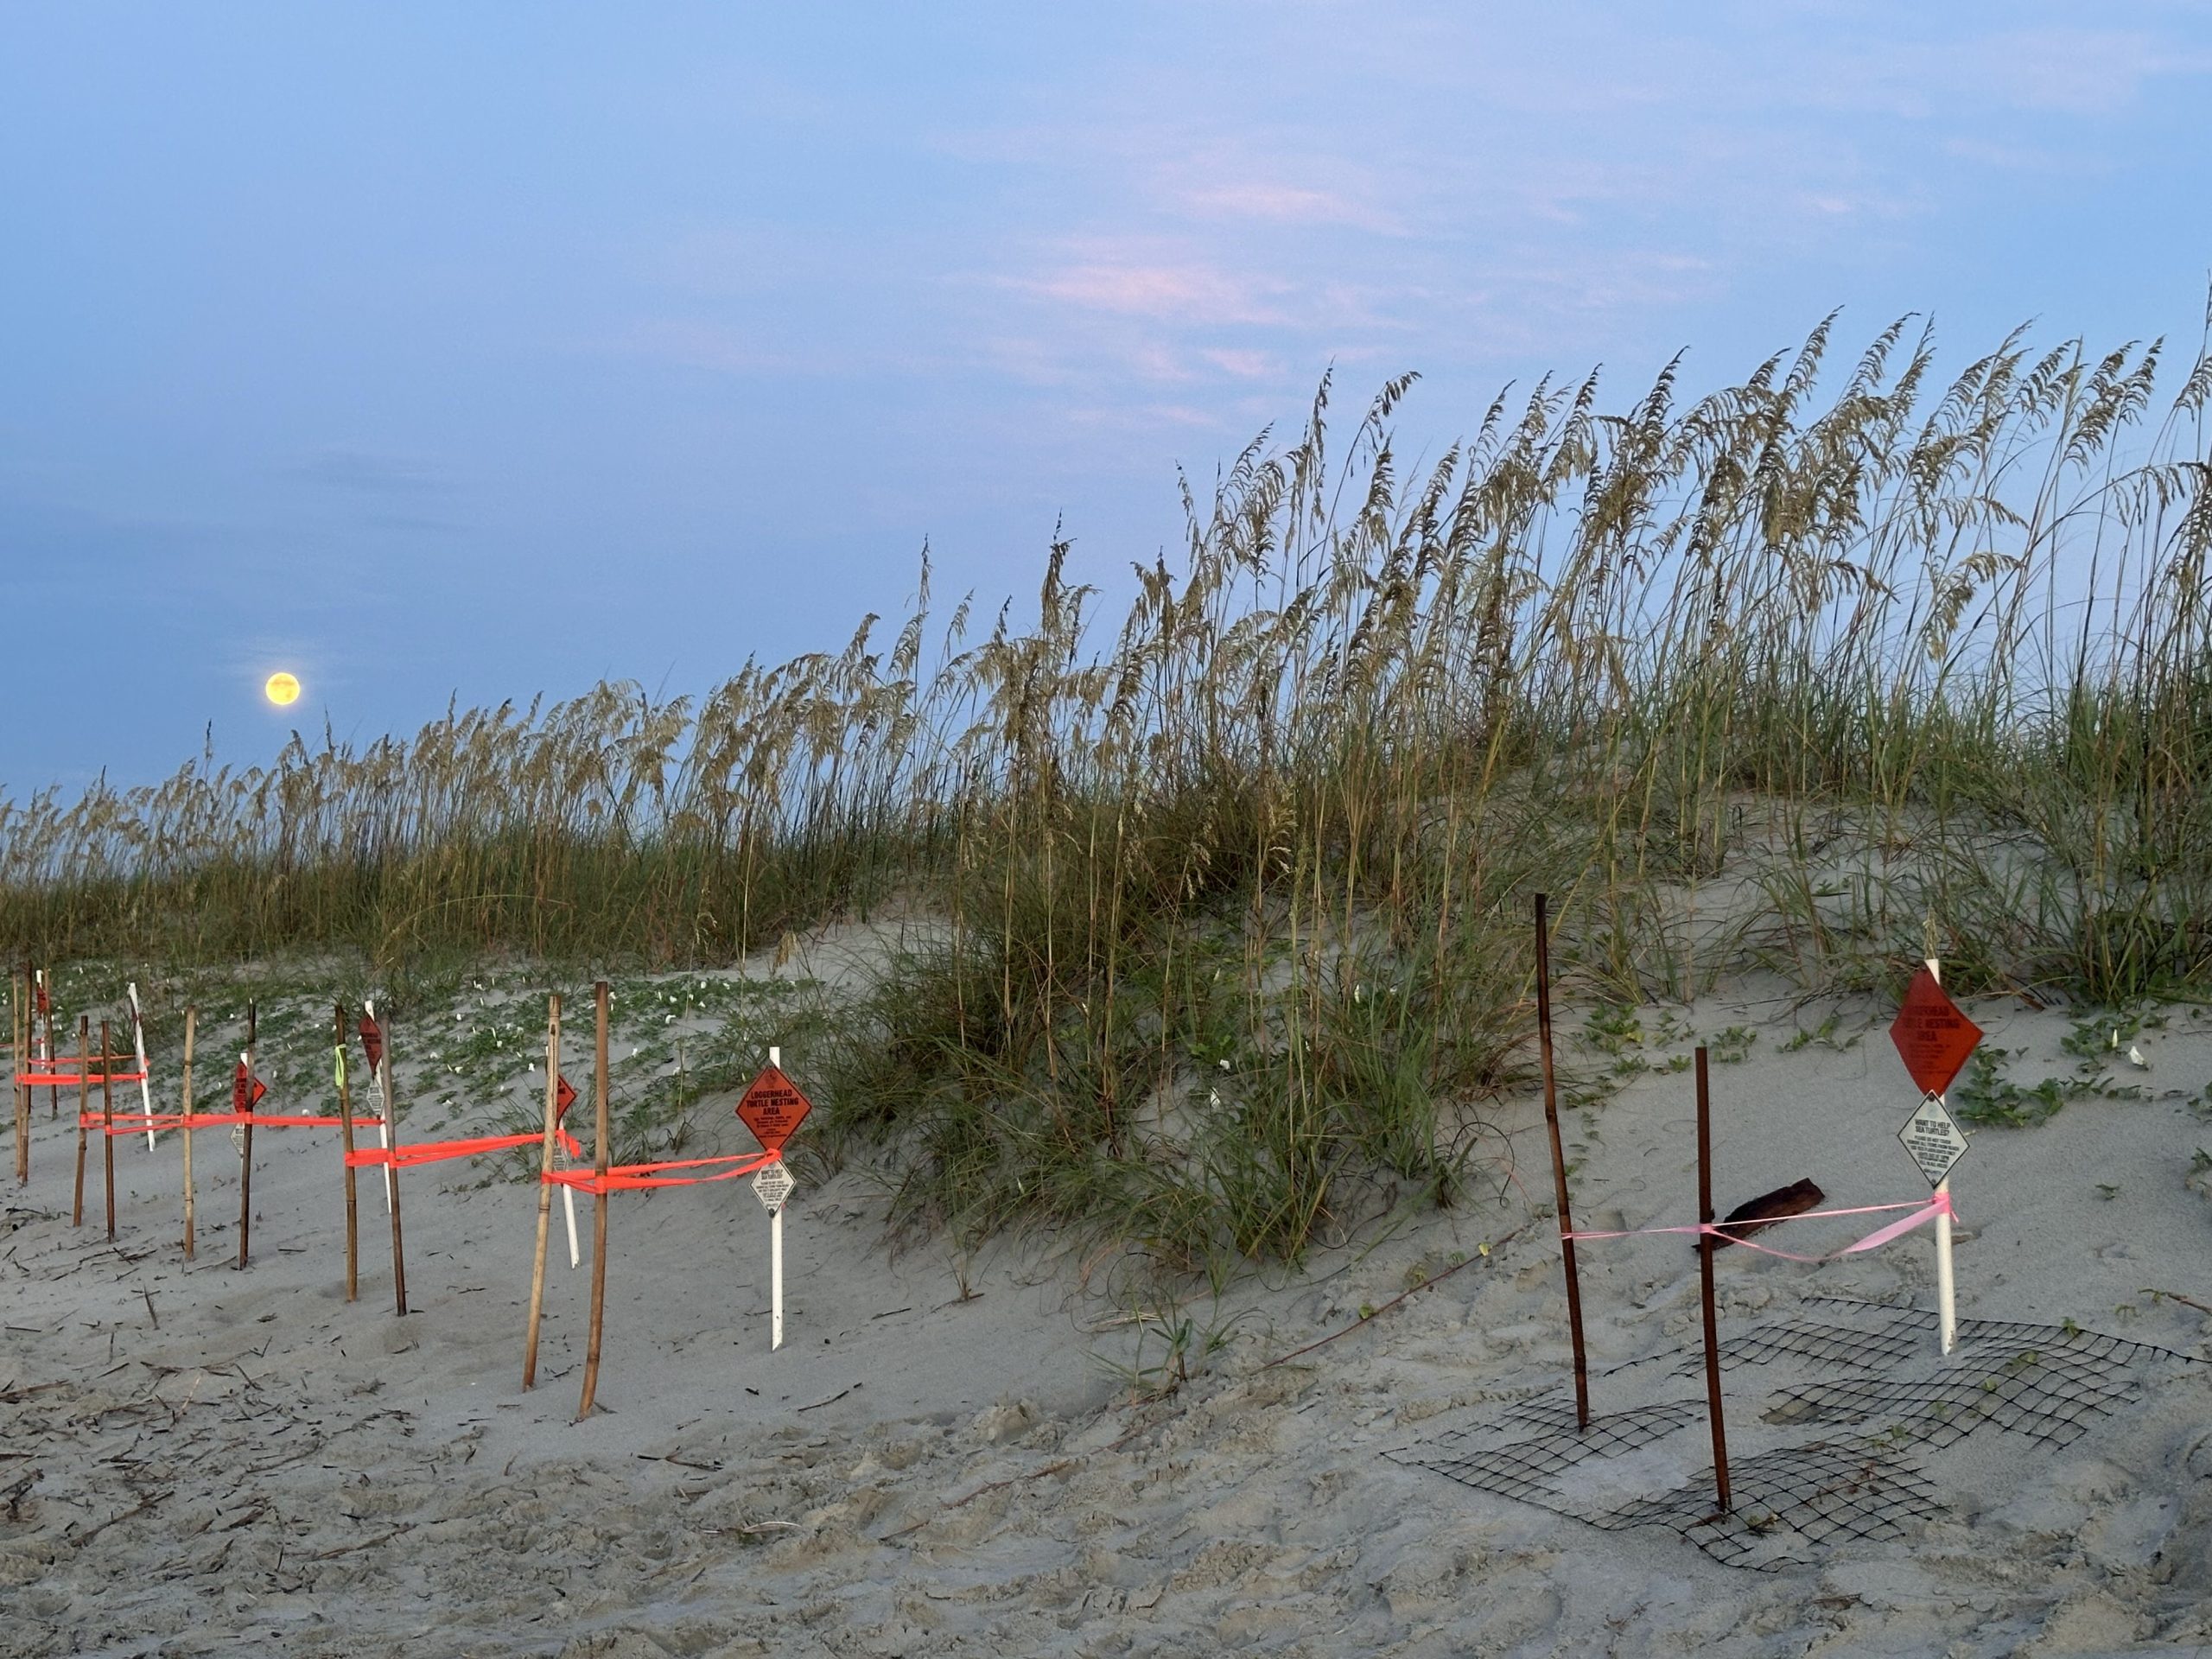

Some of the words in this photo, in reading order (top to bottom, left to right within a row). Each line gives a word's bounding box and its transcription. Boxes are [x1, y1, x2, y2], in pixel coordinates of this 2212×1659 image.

[751, 1090, 792, 1099] LOGGERHEAD
[747, 1099, 768, 1108] TURTLE
[771, 1097, 798, 1106] NESTING
[763, 1107, 780, 1116] AREA
